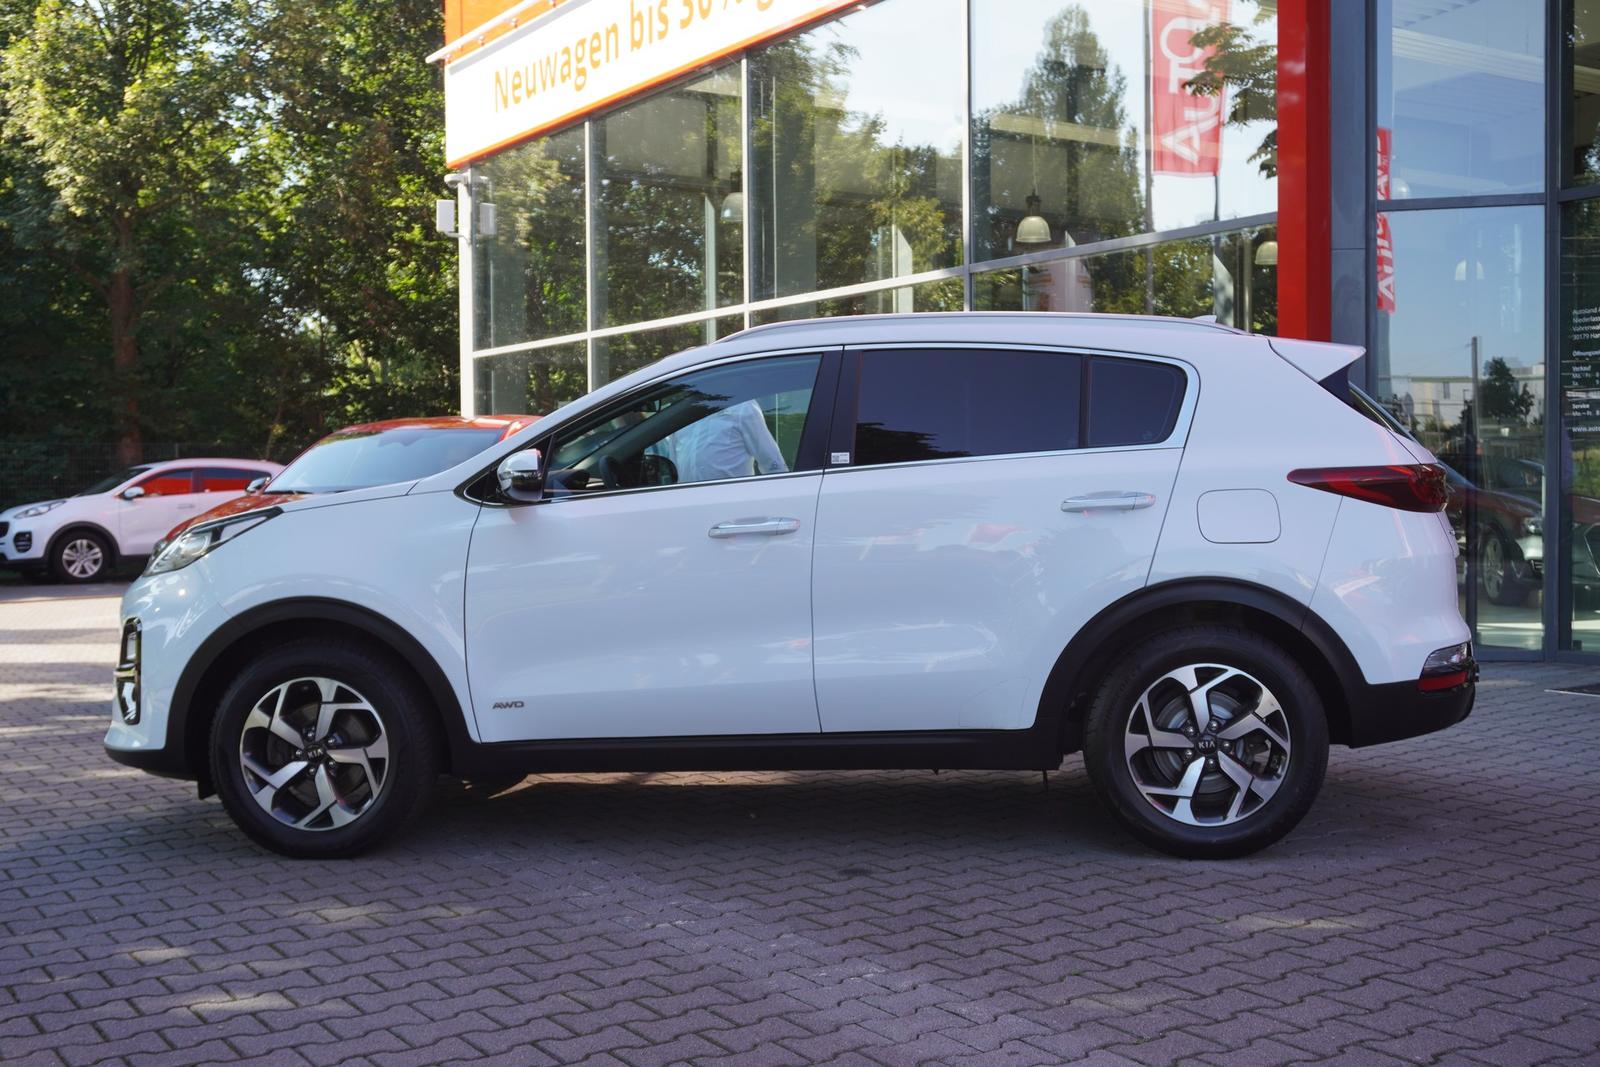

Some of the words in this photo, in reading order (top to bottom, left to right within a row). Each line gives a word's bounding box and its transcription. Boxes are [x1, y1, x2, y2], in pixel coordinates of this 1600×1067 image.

[495, 22, 619, 112] Neuwagen
[630, 0, 669, 51] bis
[492, 700, 524, 710] AWD
